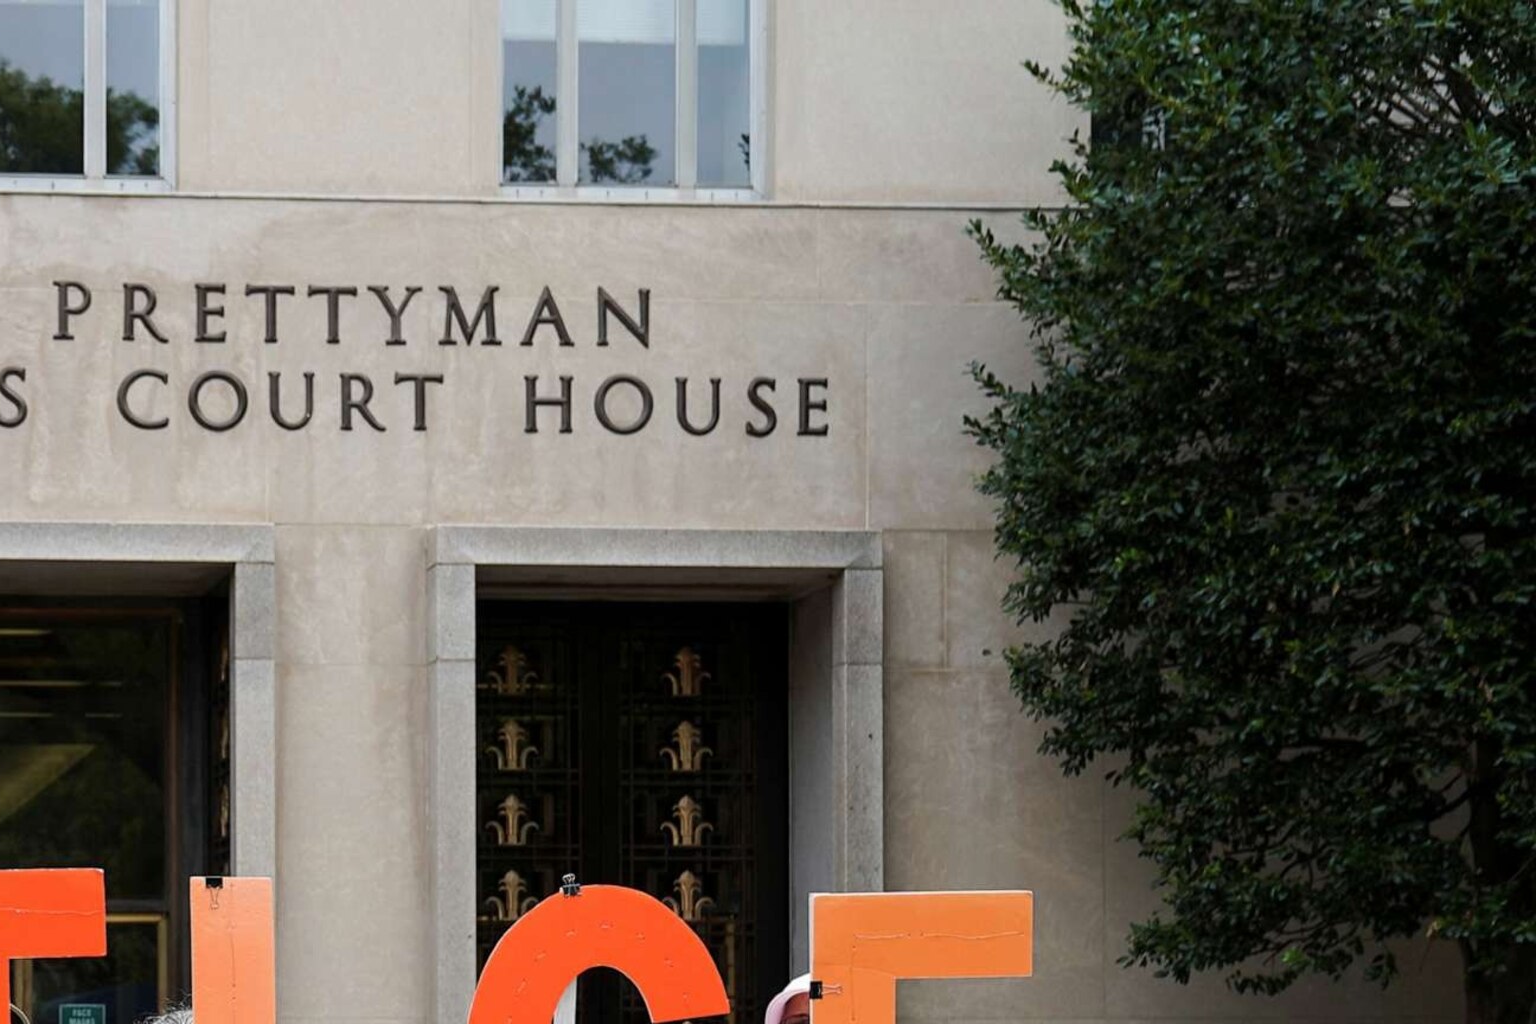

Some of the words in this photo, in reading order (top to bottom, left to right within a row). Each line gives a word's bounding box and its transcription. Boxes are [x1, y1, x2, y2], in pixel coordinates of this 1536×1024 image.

[52, 280, 652, 349] PRETTYMAN
[116, 369, 445, 432] COURT
[523, 374, 830, 437] HOUSE
